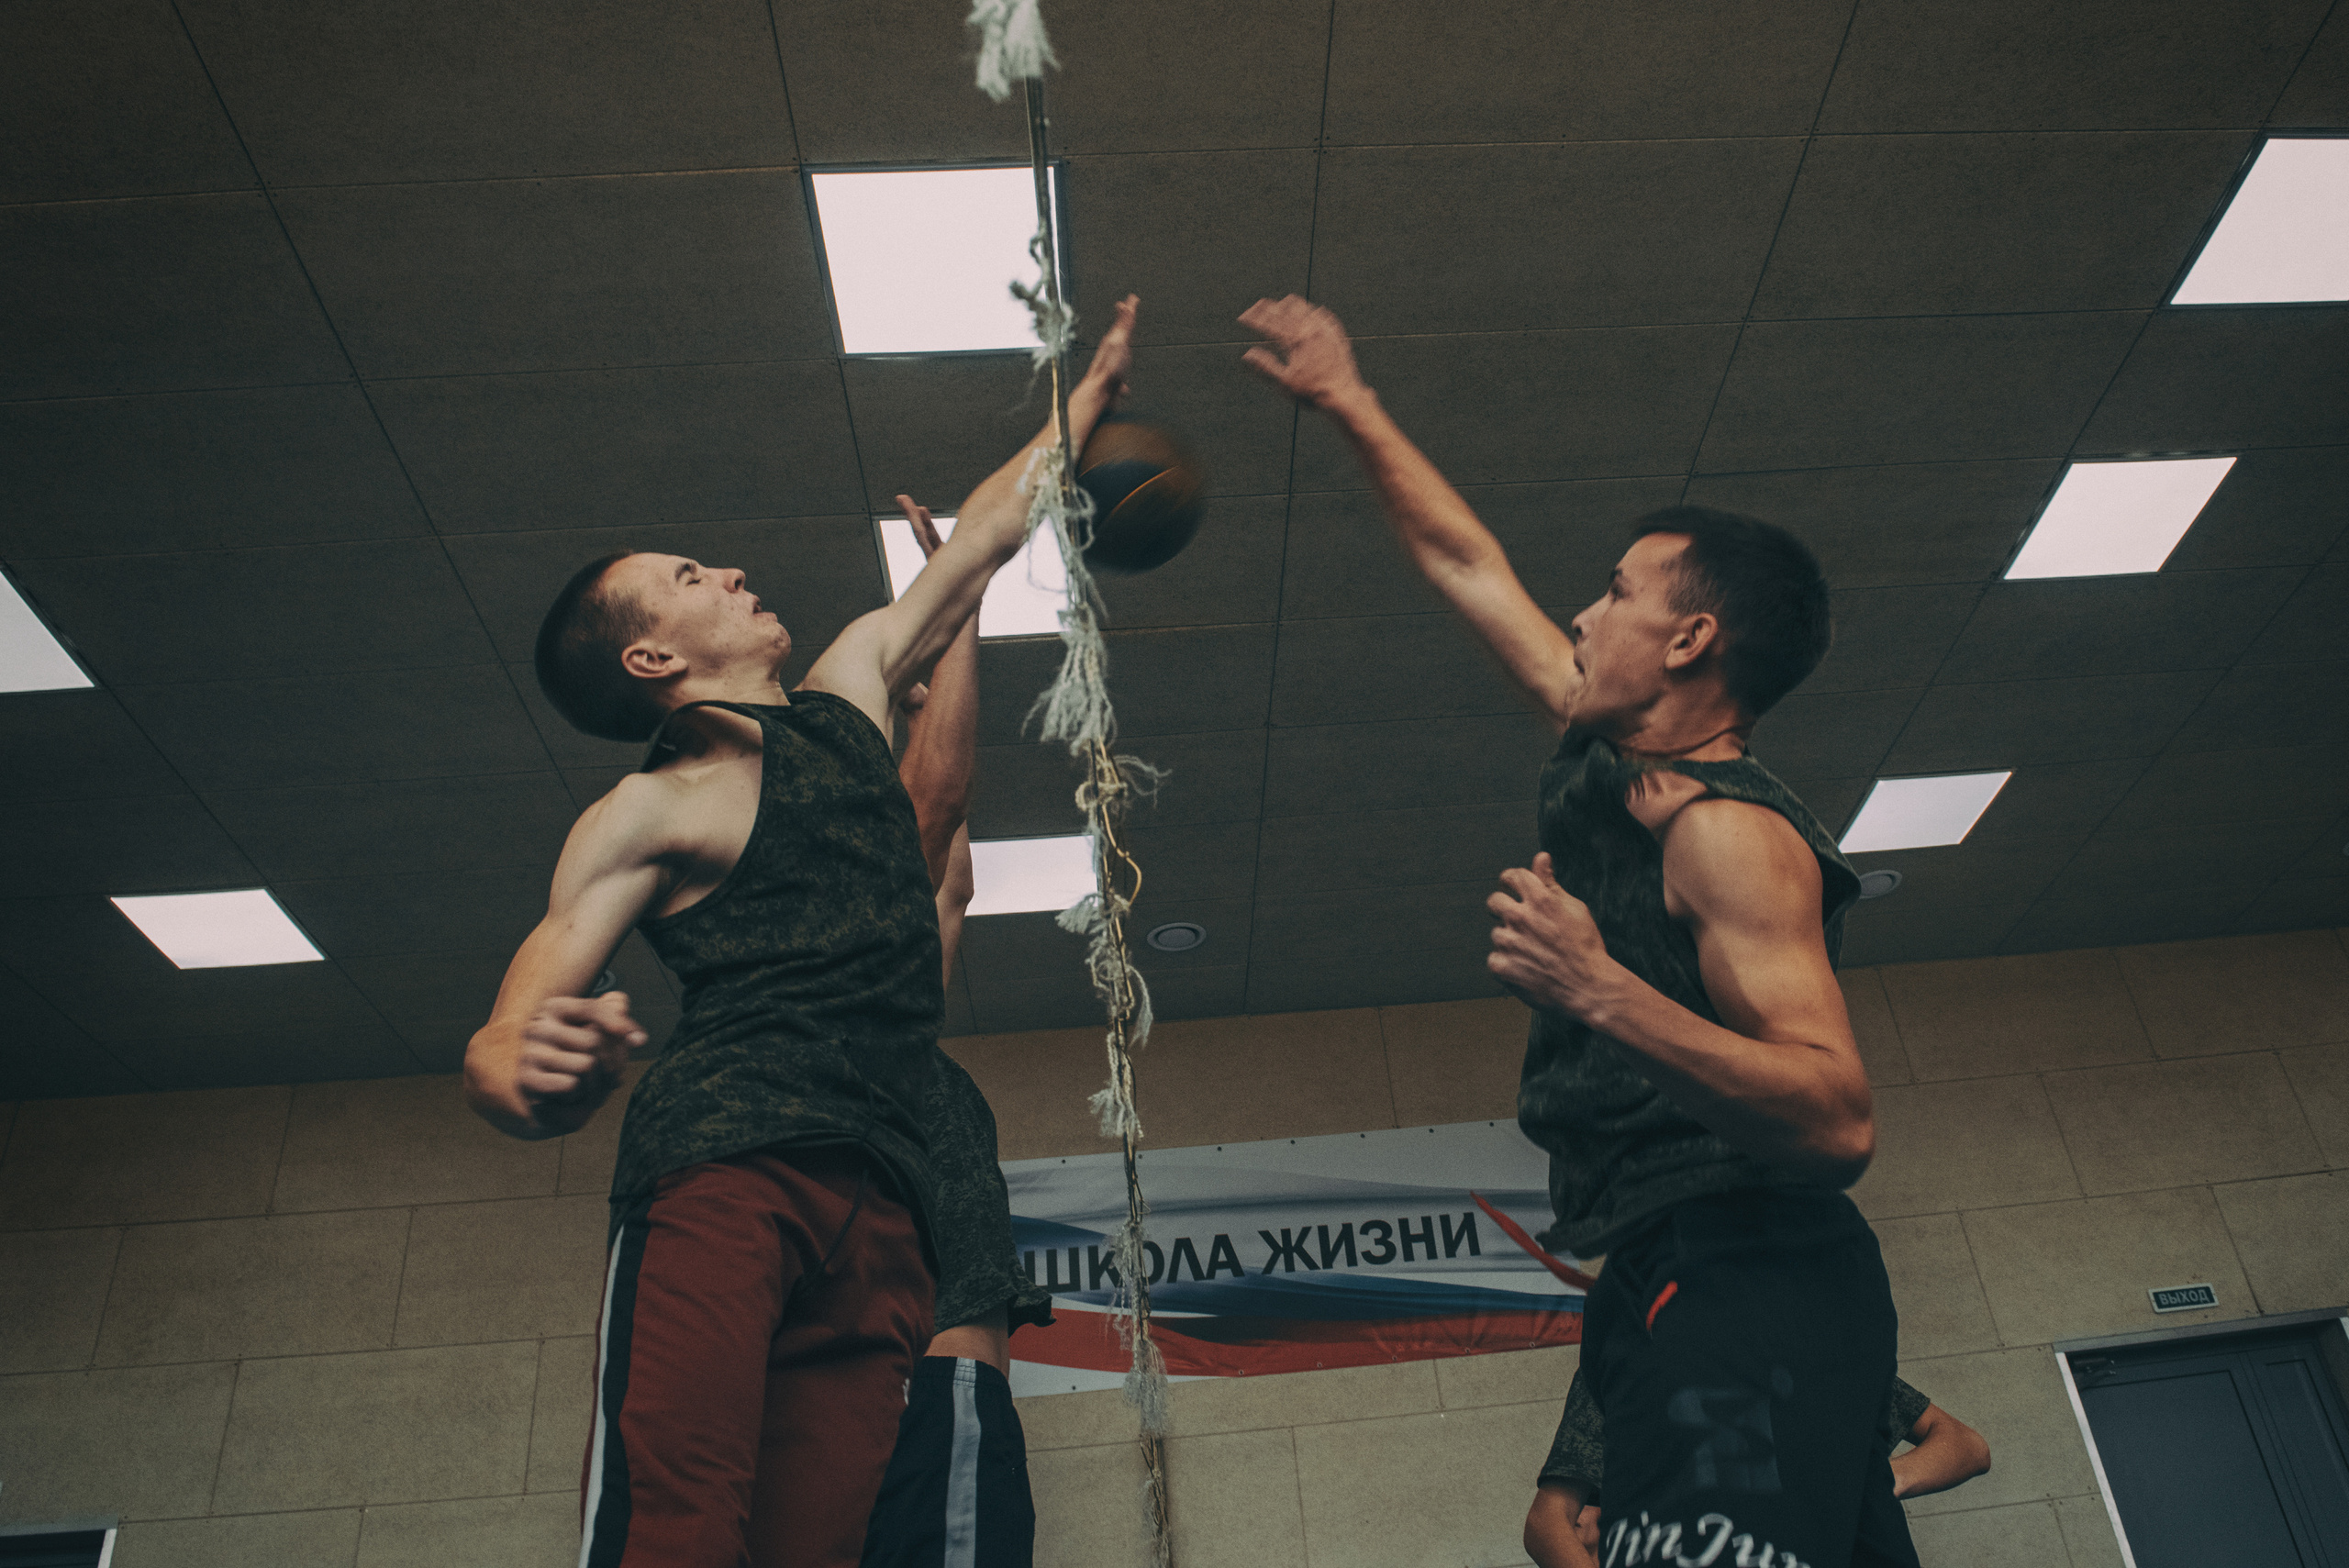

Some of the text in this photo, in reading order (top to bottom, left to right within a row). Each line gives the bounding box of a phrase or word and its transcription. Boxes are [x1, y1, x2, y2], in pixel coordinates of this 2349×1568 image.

[1023, 1211, 1481, 1294] ШКОЛА ЖИЗНИ
[2158, 1289, 2210, 1305] ВЫХОД
